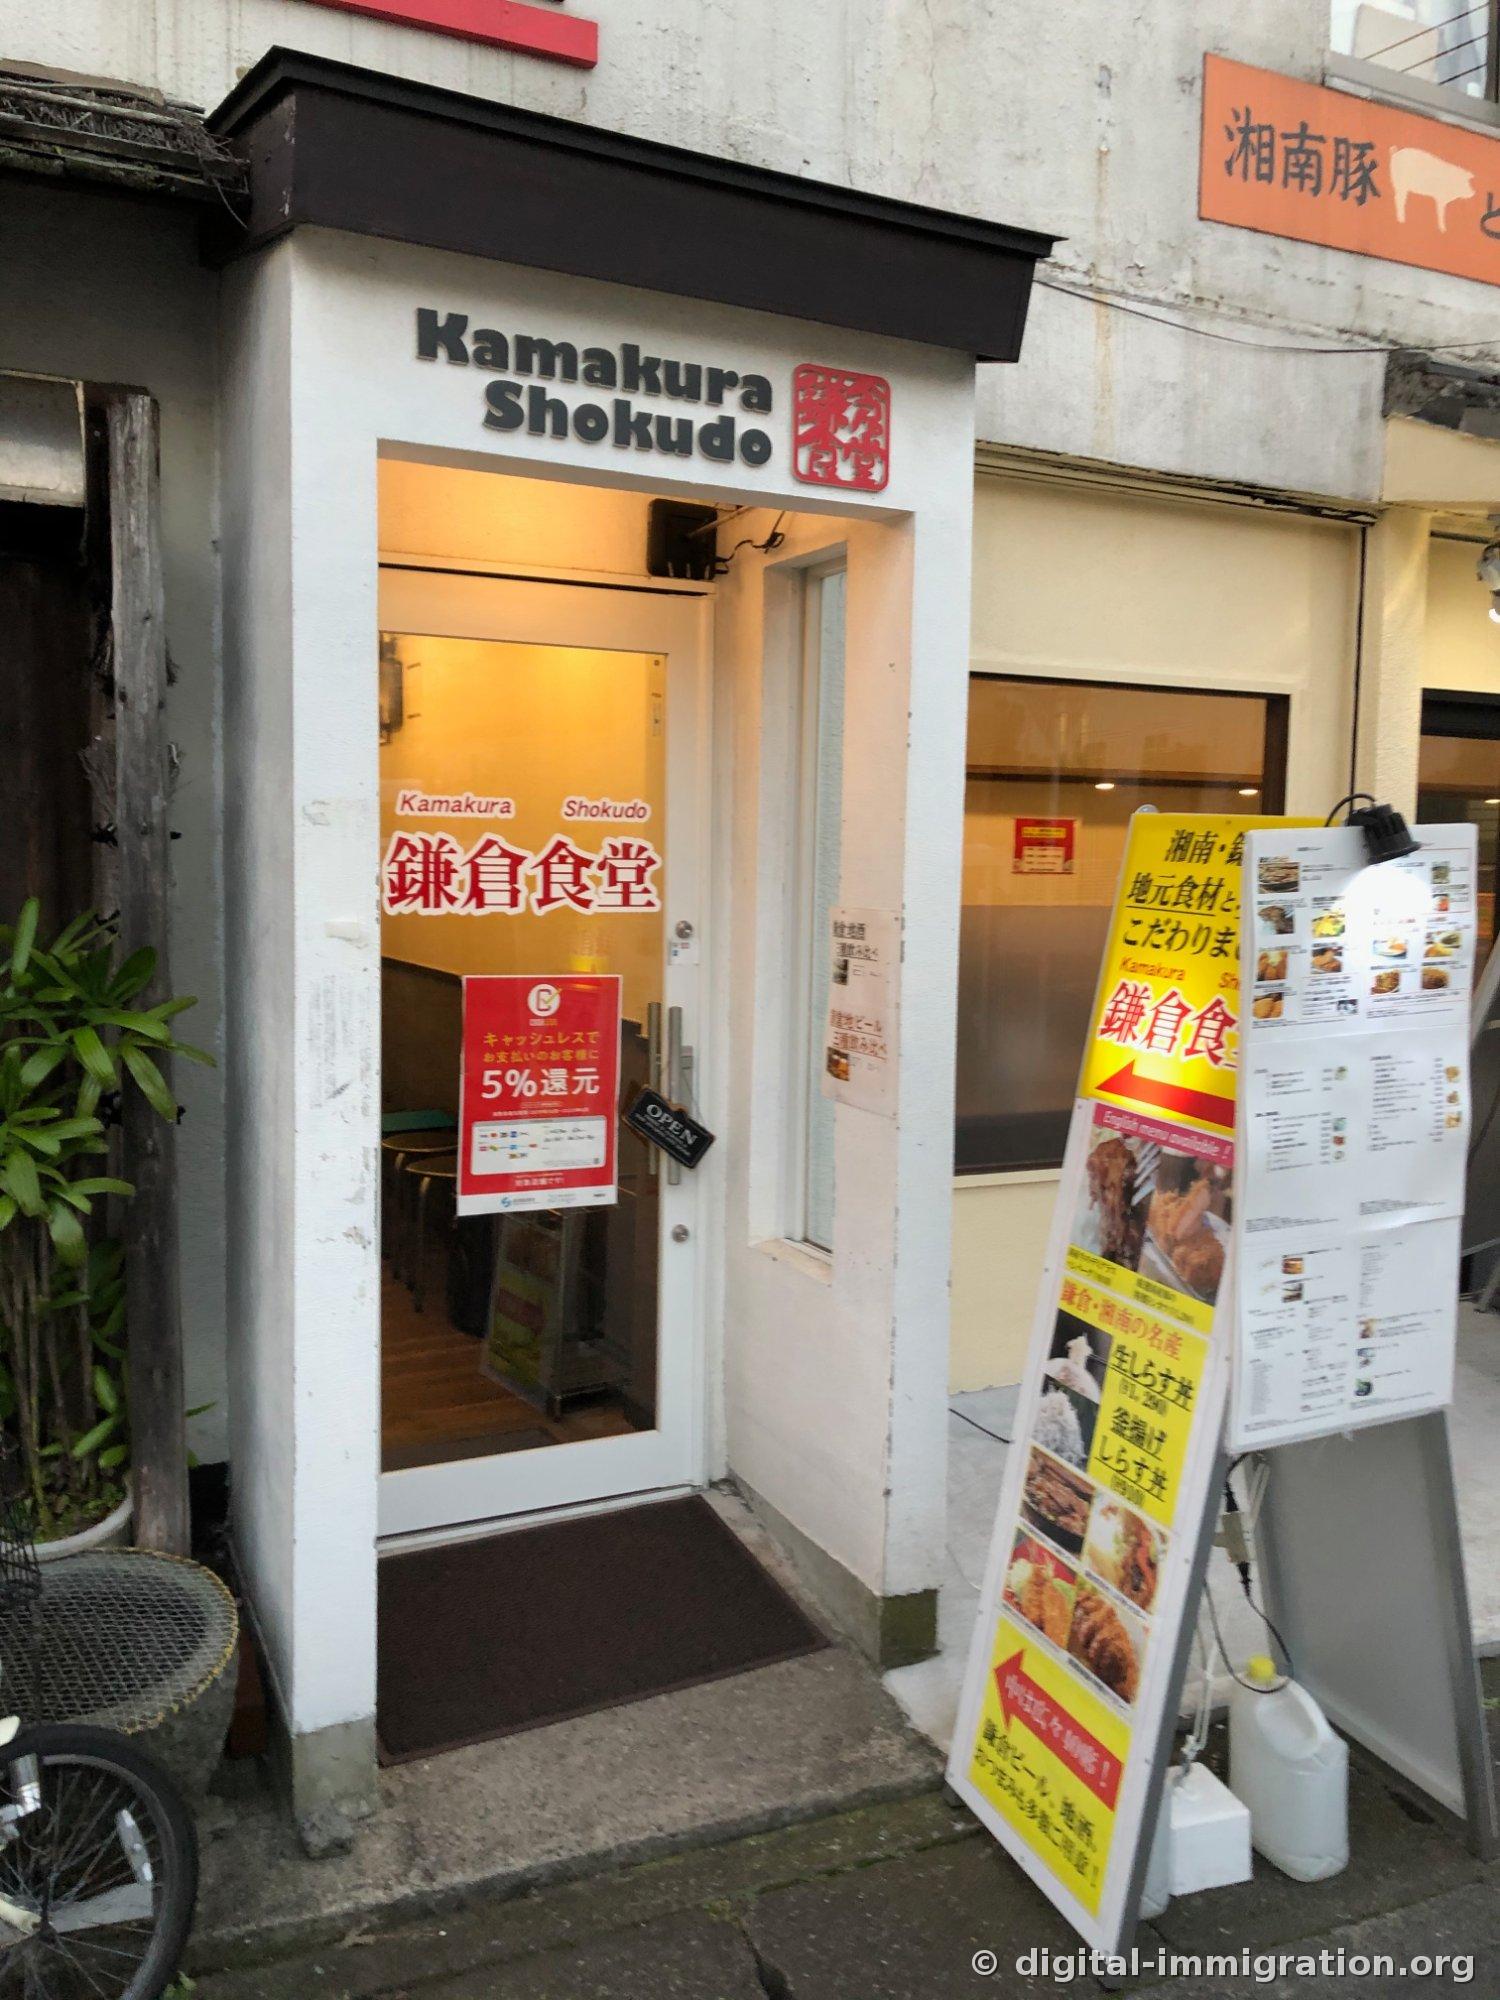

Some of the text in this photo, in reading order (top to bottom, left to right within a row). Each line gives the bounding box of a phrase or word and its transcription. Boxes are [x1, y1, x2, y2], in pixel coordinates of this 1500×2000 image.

[1224, 105, 1381, 207] 湘南豚
[416, 307, 773, 415] Kamakura
[482, 379, 773, 467] Shokudo
[399, 793, 648, 820] Kamakura Shokudo
[387, 836, 658, 910] 鎌倉食堂
[1119, 956, 1186, 981] Kamakura
[483, 1031, 600, 1047] キャッシュレスで
[1098, 981, 1240, 1069] 鎌倉食
[481, 1067, 600, 1099] 5%還元
[646, 1104, 699, 1146] OPEN
[1111, 1344, 1193, 1405] 生しらす丼
[1098, 1435, 1168, 1498] しらす丼
